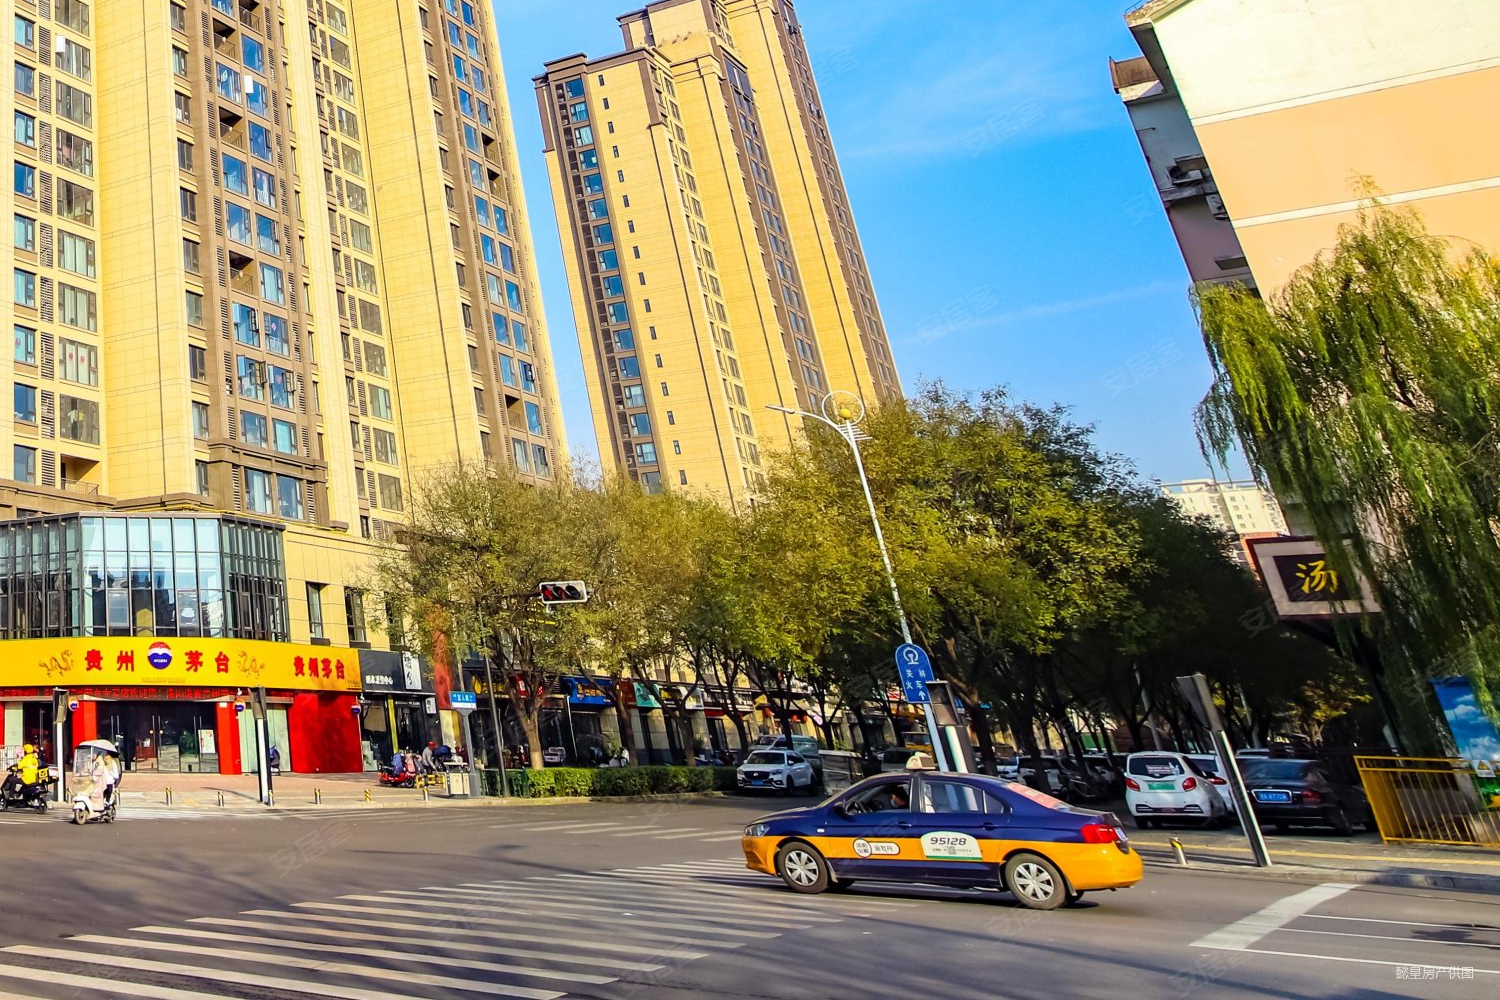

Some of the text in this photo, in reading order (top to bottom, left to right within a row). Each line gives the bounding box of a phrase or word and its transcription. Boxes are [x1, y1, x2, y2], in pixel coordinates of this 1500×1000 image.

[1296, 559, 1338, 595] 汤
[293, 655, 345, 680] 贵州茅台
[930, 838, 967, 846] 95128
